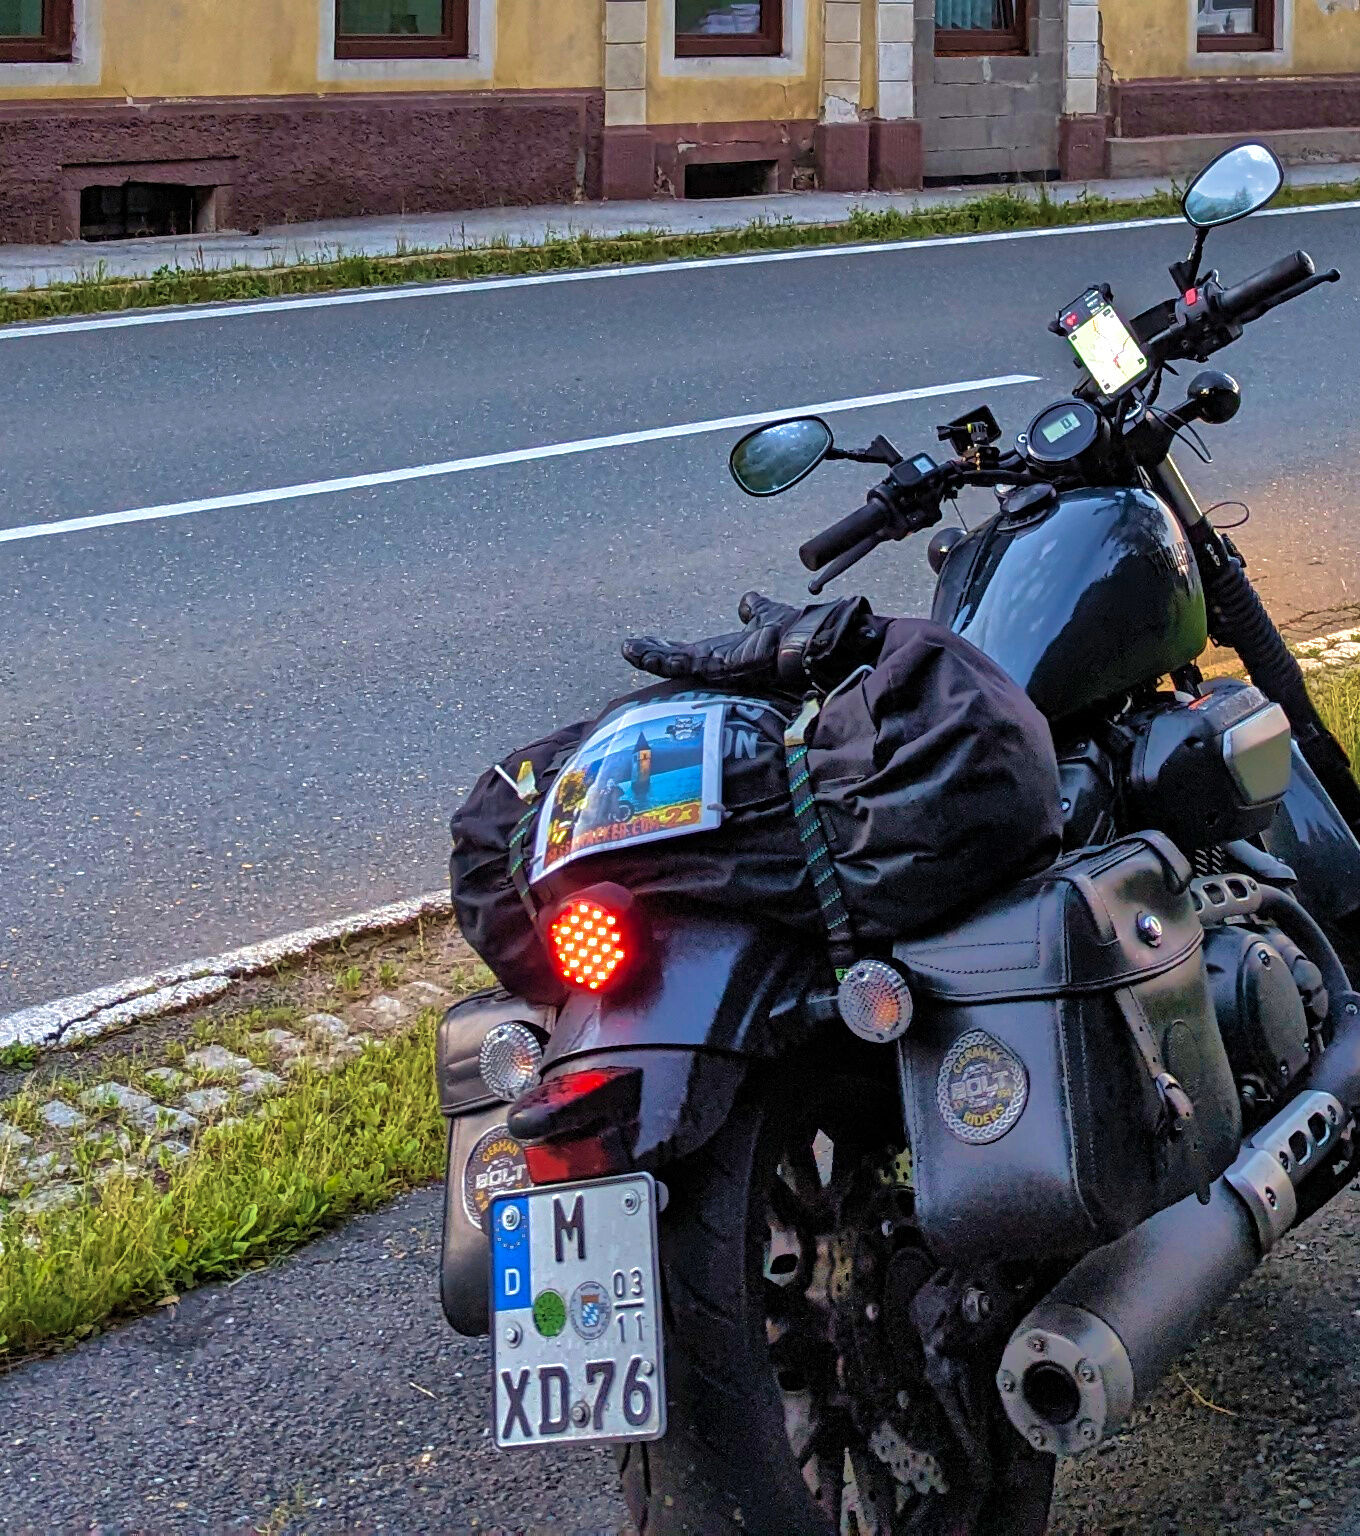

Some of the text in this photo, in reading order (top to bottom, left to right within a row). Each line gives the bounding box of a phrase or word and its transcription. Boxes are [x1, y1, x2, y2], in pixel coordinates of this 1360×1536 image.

[665, 802, 700, 827] 23
[951, 1070, 1009, 1100] BOLT
[963, 1103, 1005, 1126] RIDERS
[475, 1163, 527, 1189] BOLT
[551, 1192, 586, 1263] M
[504, 1267, 521, 1296] D
[613, 1267, 643, 1298] 03
[614, 1311, 644, 1343] 11
[501, 1354, 652, 1440] XD 76
